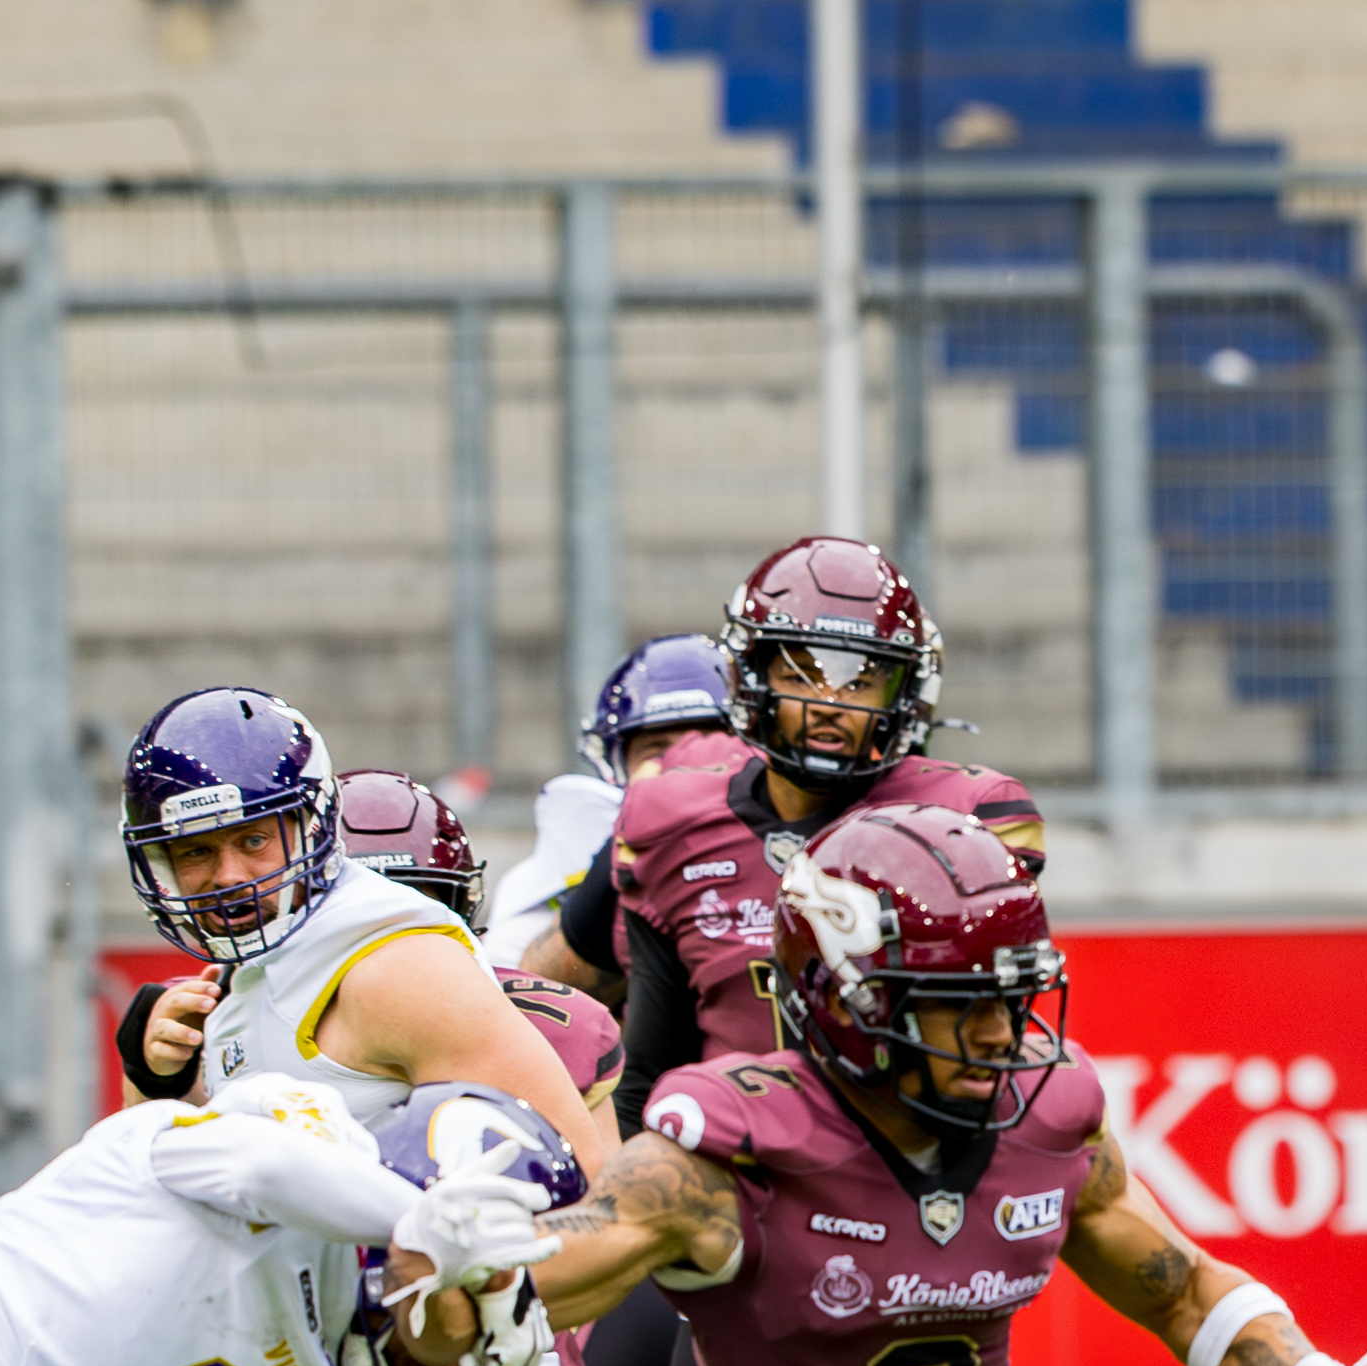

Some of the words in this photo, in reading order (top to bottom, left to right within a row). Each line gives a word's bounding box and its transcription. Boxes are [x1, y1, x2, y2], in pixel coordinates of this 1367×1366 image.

[816, 614, 877, 637] FORELLE
[179, 792, 221, 813] FORELLE
[1004, 1195, 1062, 1235] AFLE
